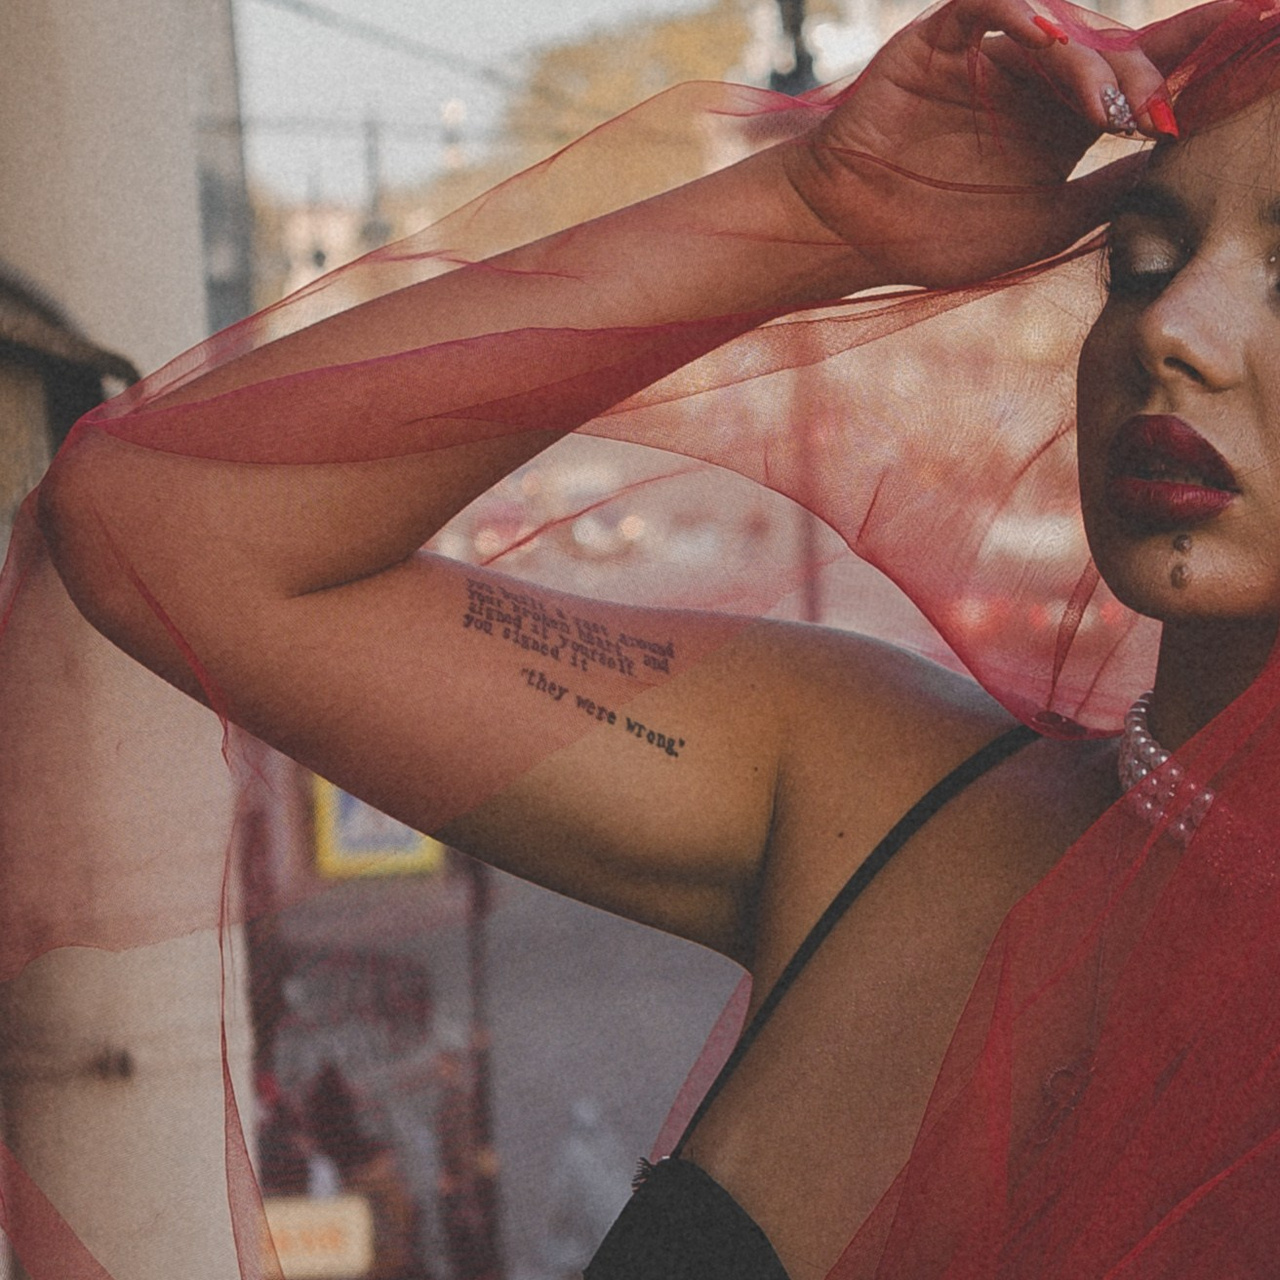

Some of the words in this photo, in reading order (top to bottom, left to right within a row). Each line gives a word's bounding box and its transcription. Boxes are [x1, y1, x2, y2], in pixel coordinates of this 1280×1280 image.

[463, 613, 493, 636] you
[502, 626, 560, 662] signed
[466, 588, 503, 608] your
[511, 601, 571, 635] broken
[643, 653, 671, 675] and
[467, 578, 494, 595] you
[620, 633, 674, 658] around
[468, 601, 523, 630] signed
[521, 668, 569, 701] "they
[576, 695, 617, 726] were
